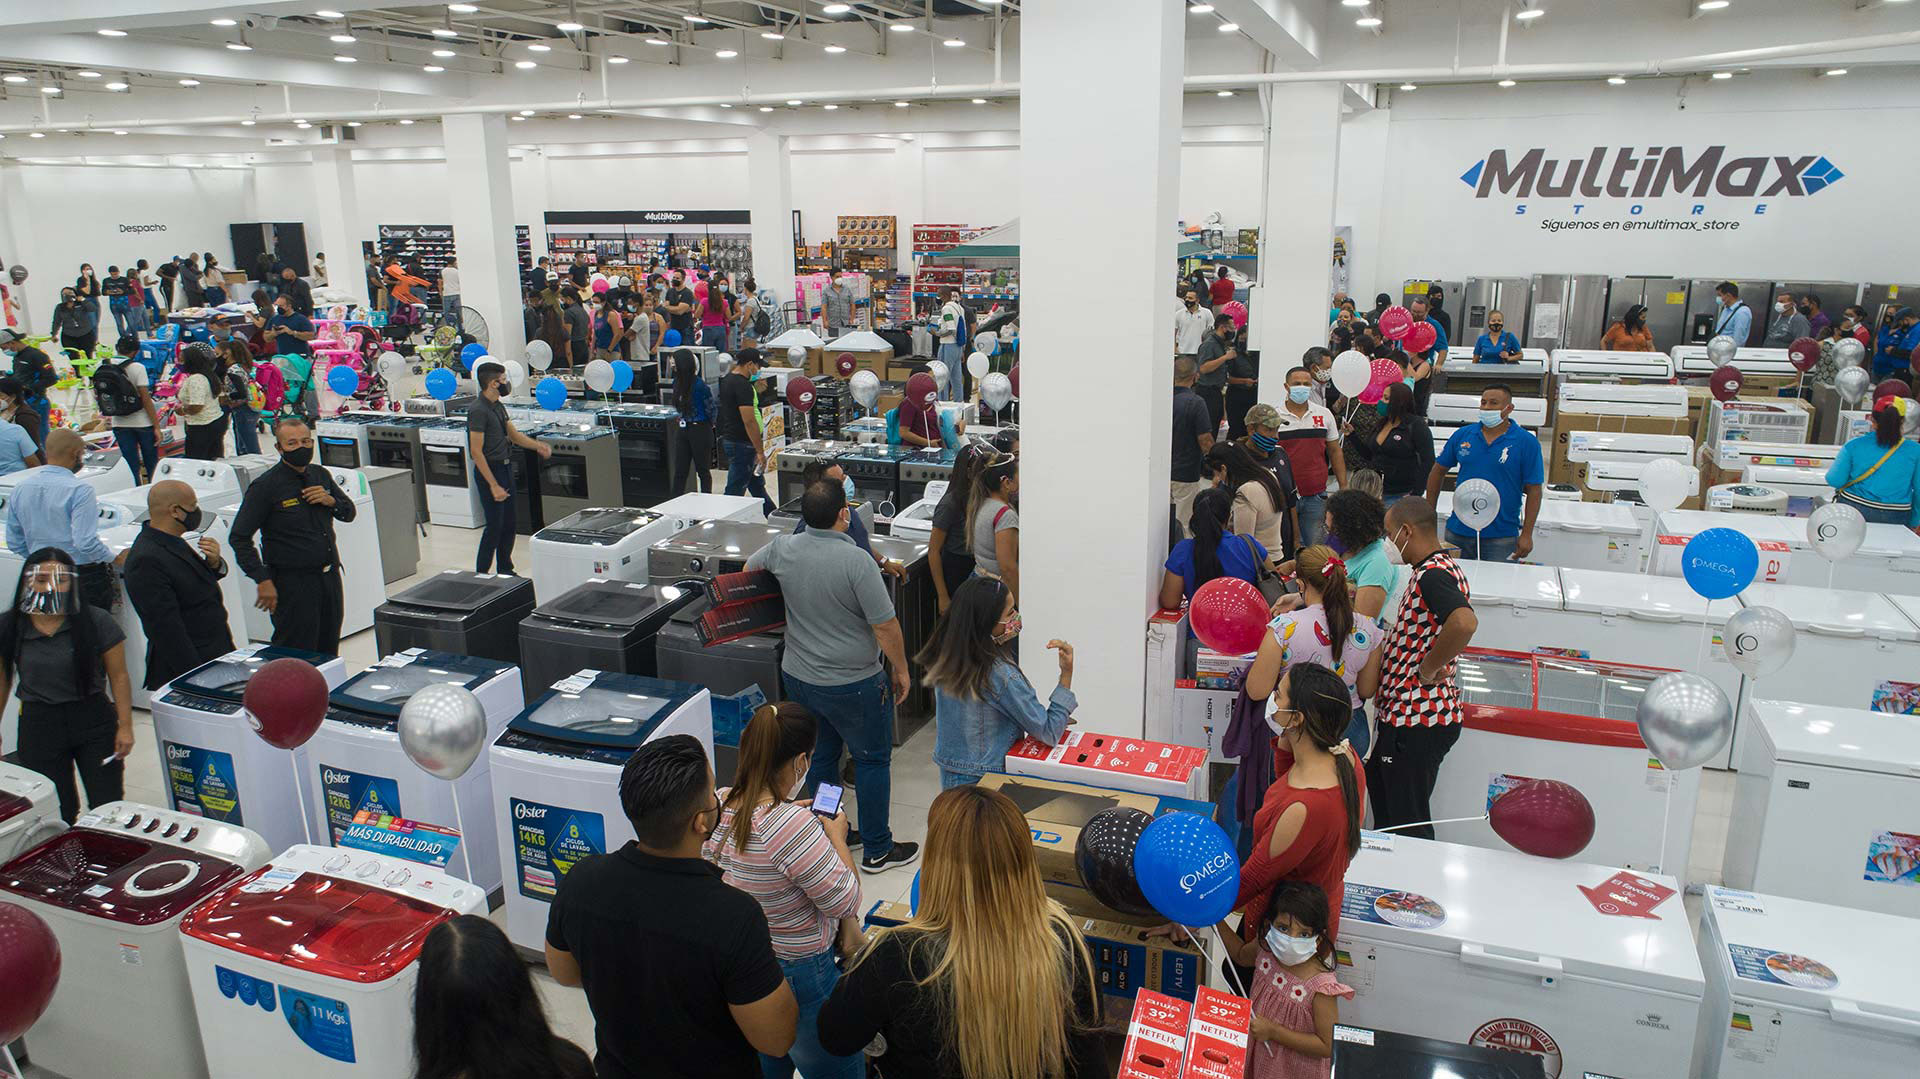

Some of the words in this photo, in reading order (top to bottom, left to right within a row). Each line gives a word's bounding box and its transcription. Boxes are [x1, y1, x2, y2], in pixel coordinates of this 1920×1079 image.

[1475, 145, 1817, 198] MultiMax
[646, 212, 682, 221] MultiMax
[1515, 204, 1767, 215] STORE
[119, 224, 167, 235] Despacho
[1541, 218, 1600, 232] Síguenos
[1602, 220, 1620, 230] en
[1622, 219, 1740, 232] @multimax_store
[1692, 557, 1737, 576] OMEGA
[168, 745, 191, 759] Oster
[208, 763, 216, 775] 8
[324, 769, 351, 784] Oster
[328, 795, 351, 810] 12KG
[370, 790, 378, 803] 8
[514, 802, 547, 820] Oster
[519, 824, 545, 835] CAPACIDAD
[569, 825, 579, 839] 8
[346, 825, 374, 840] MÁS
[371, 831, 442, 855] DURABILIDAD
[519, 831, 546, 847] 14KG
[565, 838, 584, 846] CICLOS
[519, 845, 527, 856] 2
[569, 843, 590, 852] LAVADO
[1180, 851, 1232, 894] OMEGA
[1621, 890, 1636, 898] de
[1622, 882, 1661, 901] favorito
[1608, 892, 1638, 907] todos
[1385, 913, 1431, 927] CONDESA
[1175, 957, 1183, 975] LED
[1174, 977, 1183, 988] TV
[1146, 998, 1180, 1013] aiwa
[1206, 995, 1241, 1009] aiwa
[311, 1006, 323, 1019] 11
[326, 1009, 348, 1025] Kgs.
[1148, 1008, 1175, 1019] 39"
[1209, 1005, 1236, 1017] 39"
[1636, 1019, 1670, 1030] CONDESA
[1138, 1027, 1177, 1045] NETFLIX
[1201, 1024, 1239, 1042] NETFLIX
[1509, 1021, 1556, 1051] RENDIMIENTO
[1504, 1032, 1532, 1049] 100
